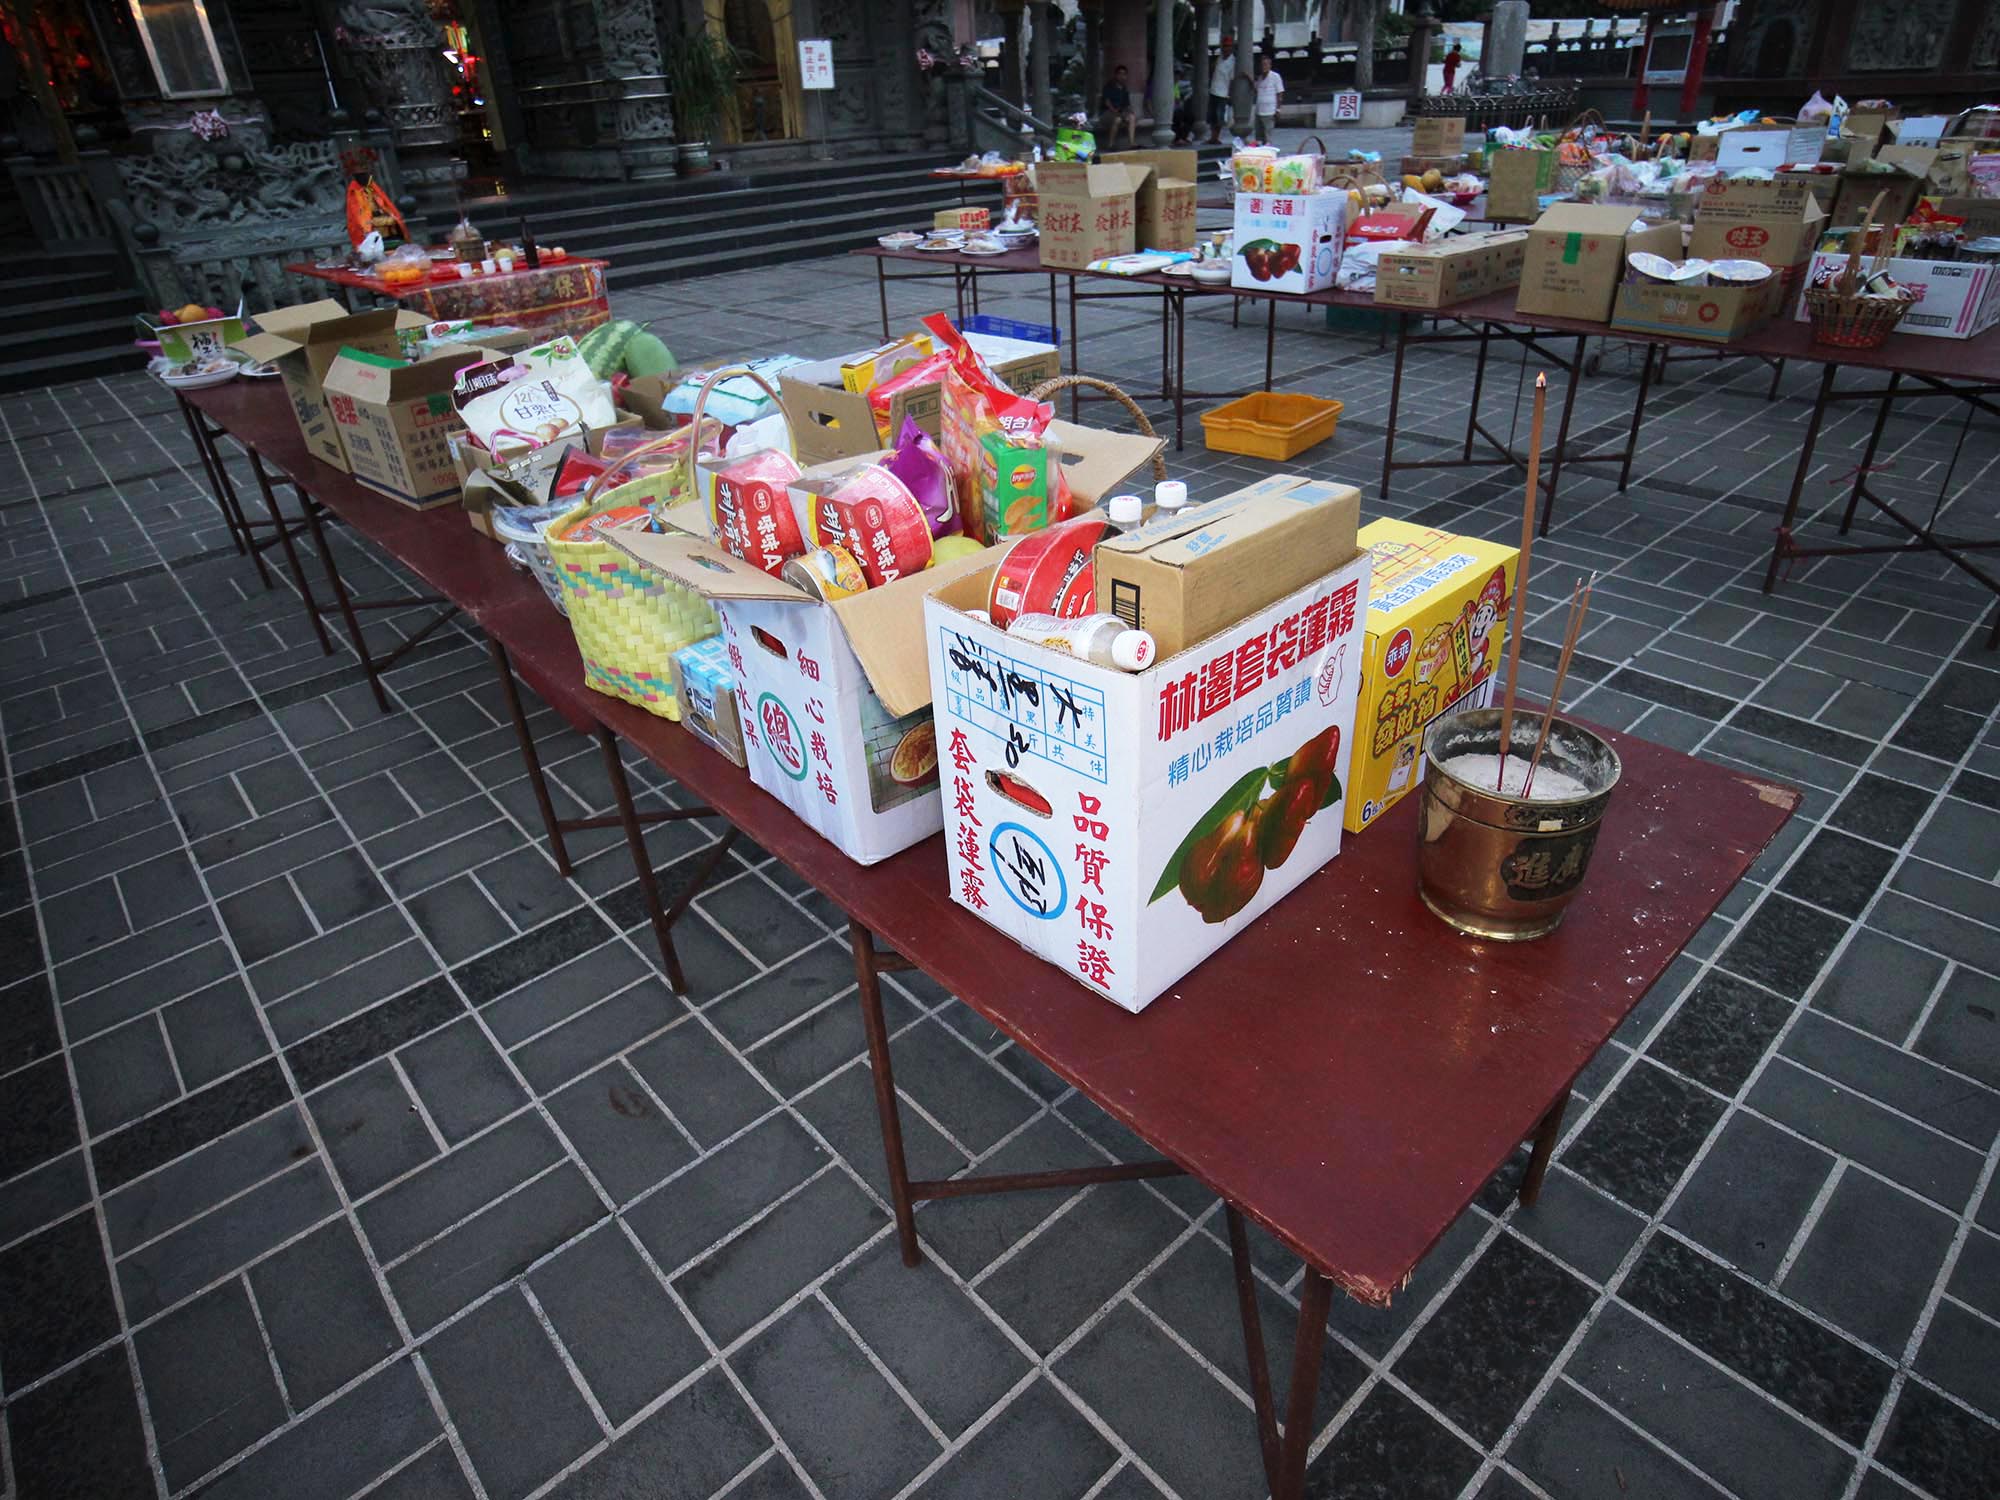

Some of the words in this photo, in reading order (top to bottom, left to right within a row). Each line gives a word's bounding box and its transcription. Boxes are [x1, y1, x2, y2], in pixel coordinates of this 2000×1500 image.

[757, 515, 783, 571] 味味A
[796, 647, 838, 806] 細心栽培
[1158, 578, 1359, 742] 林邊套袋蓮霧
[1387, 640, 1409, 668] 乖乖
[948, 727, 990, 909] 套袋蓮霧
[1073, 791, 1116, 990] 品質保證
